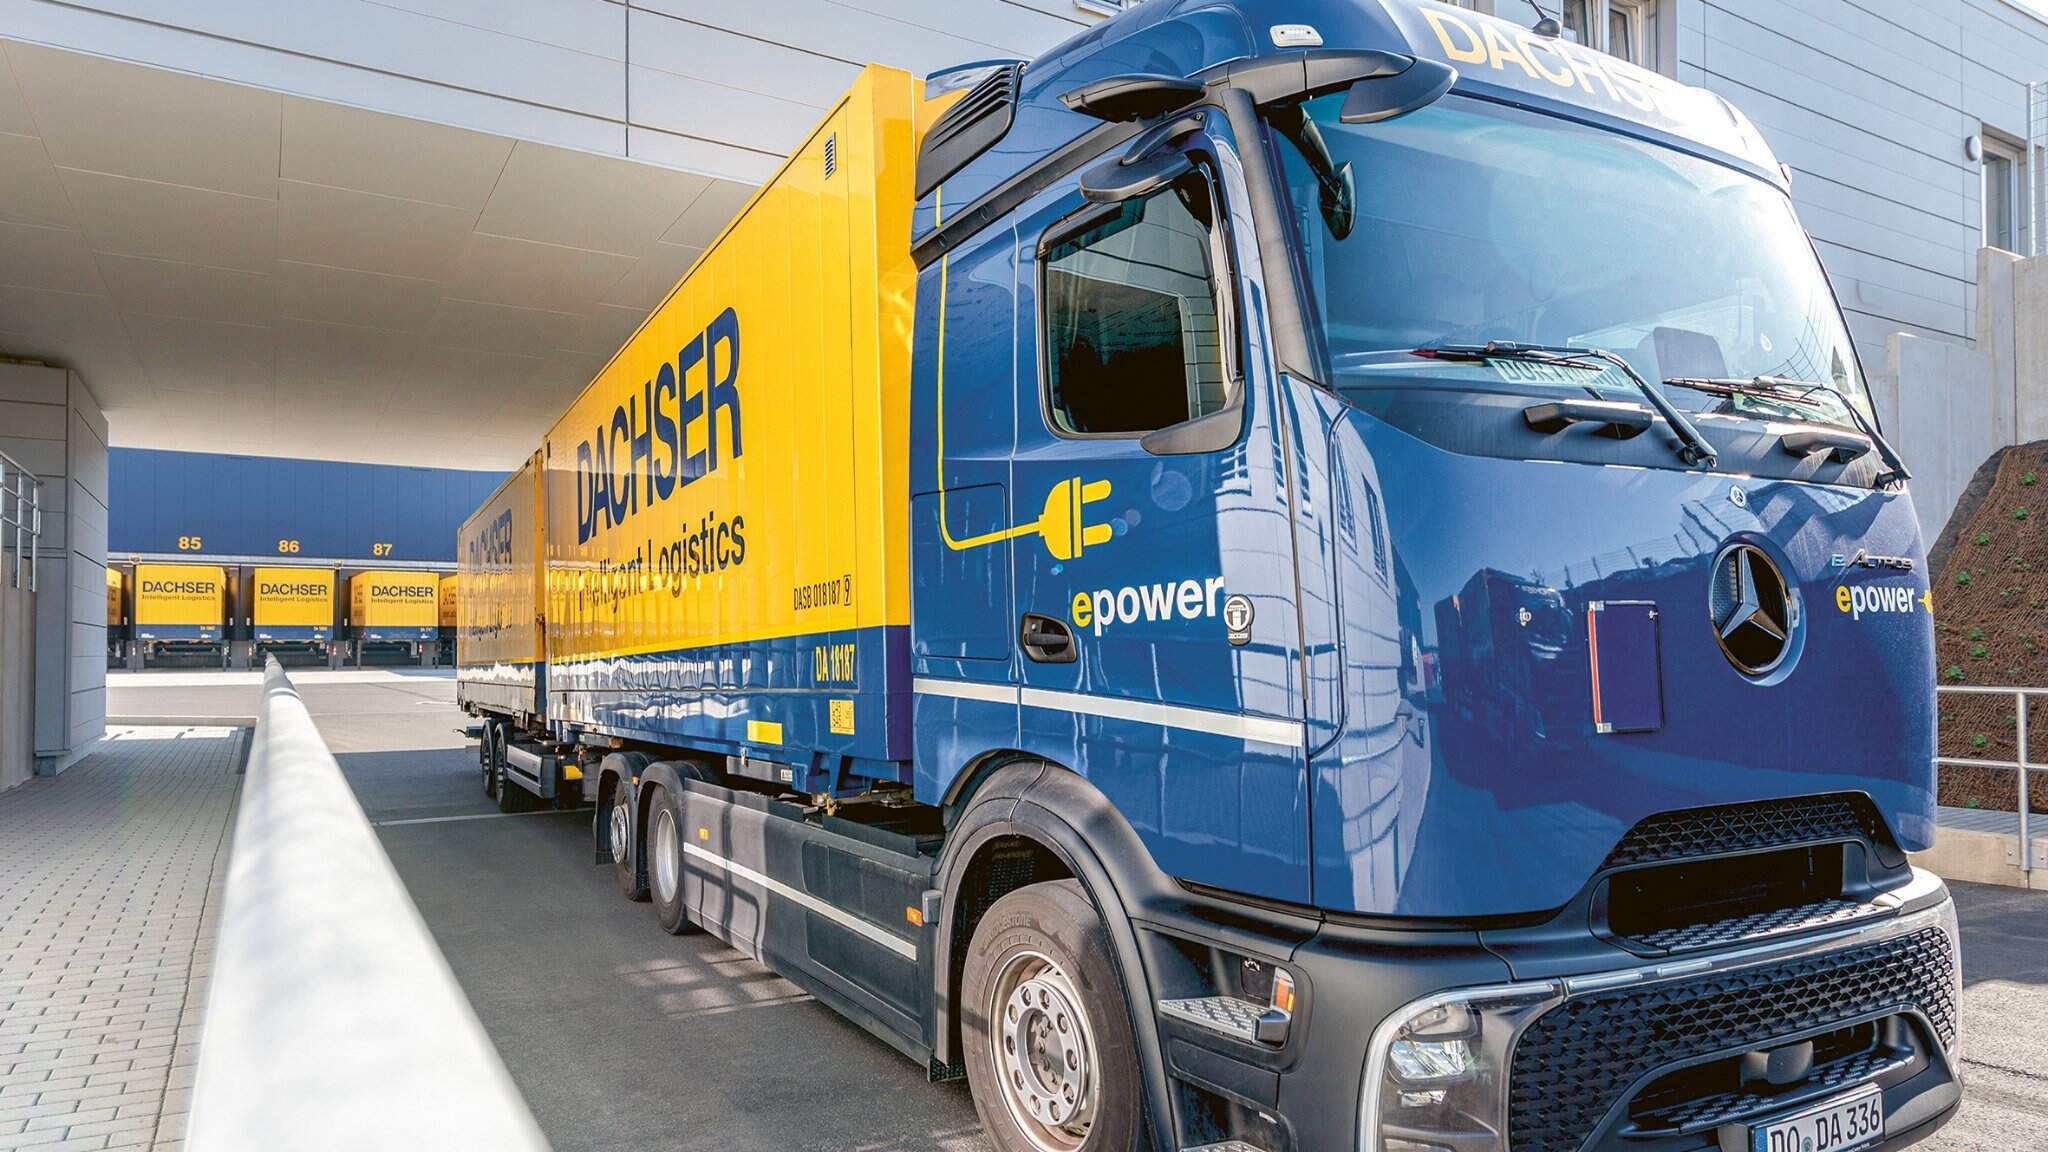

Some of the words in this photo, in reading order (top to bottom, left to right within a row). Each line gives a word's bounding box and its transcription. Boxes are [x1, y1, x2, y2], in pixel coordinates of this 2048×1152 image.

[1418, 7, 1675, 114] DACHS
[577, 307, 743, 545] DACHSER
[178, 536, 202, 550] 85
[278, 539, 300, 553] 86
[373, 543, 393, 556] 87
[648, 511, 745, 598] Logistics
[142, 581, 216, 594] DACHSER
[260, 583, 328, 596] DACHSER
[371, 585, 434, 598] DACHSER
[793, 586, 812, 611] DASB
[813, 579, 841, 608] 018187
[844, 577, 851, 604] 9
[1835, 585, 1916, 621] epower
[1071, 575, 1225, 638] epower
[815, 646, 829, 682] DA
[830, 643, 855, 682] 18187
[1770, 1126, 1800, 1152] DO
[1815, 1112, 1842, 1151] DA
[1846, 1099, 1880, 1140] 336
